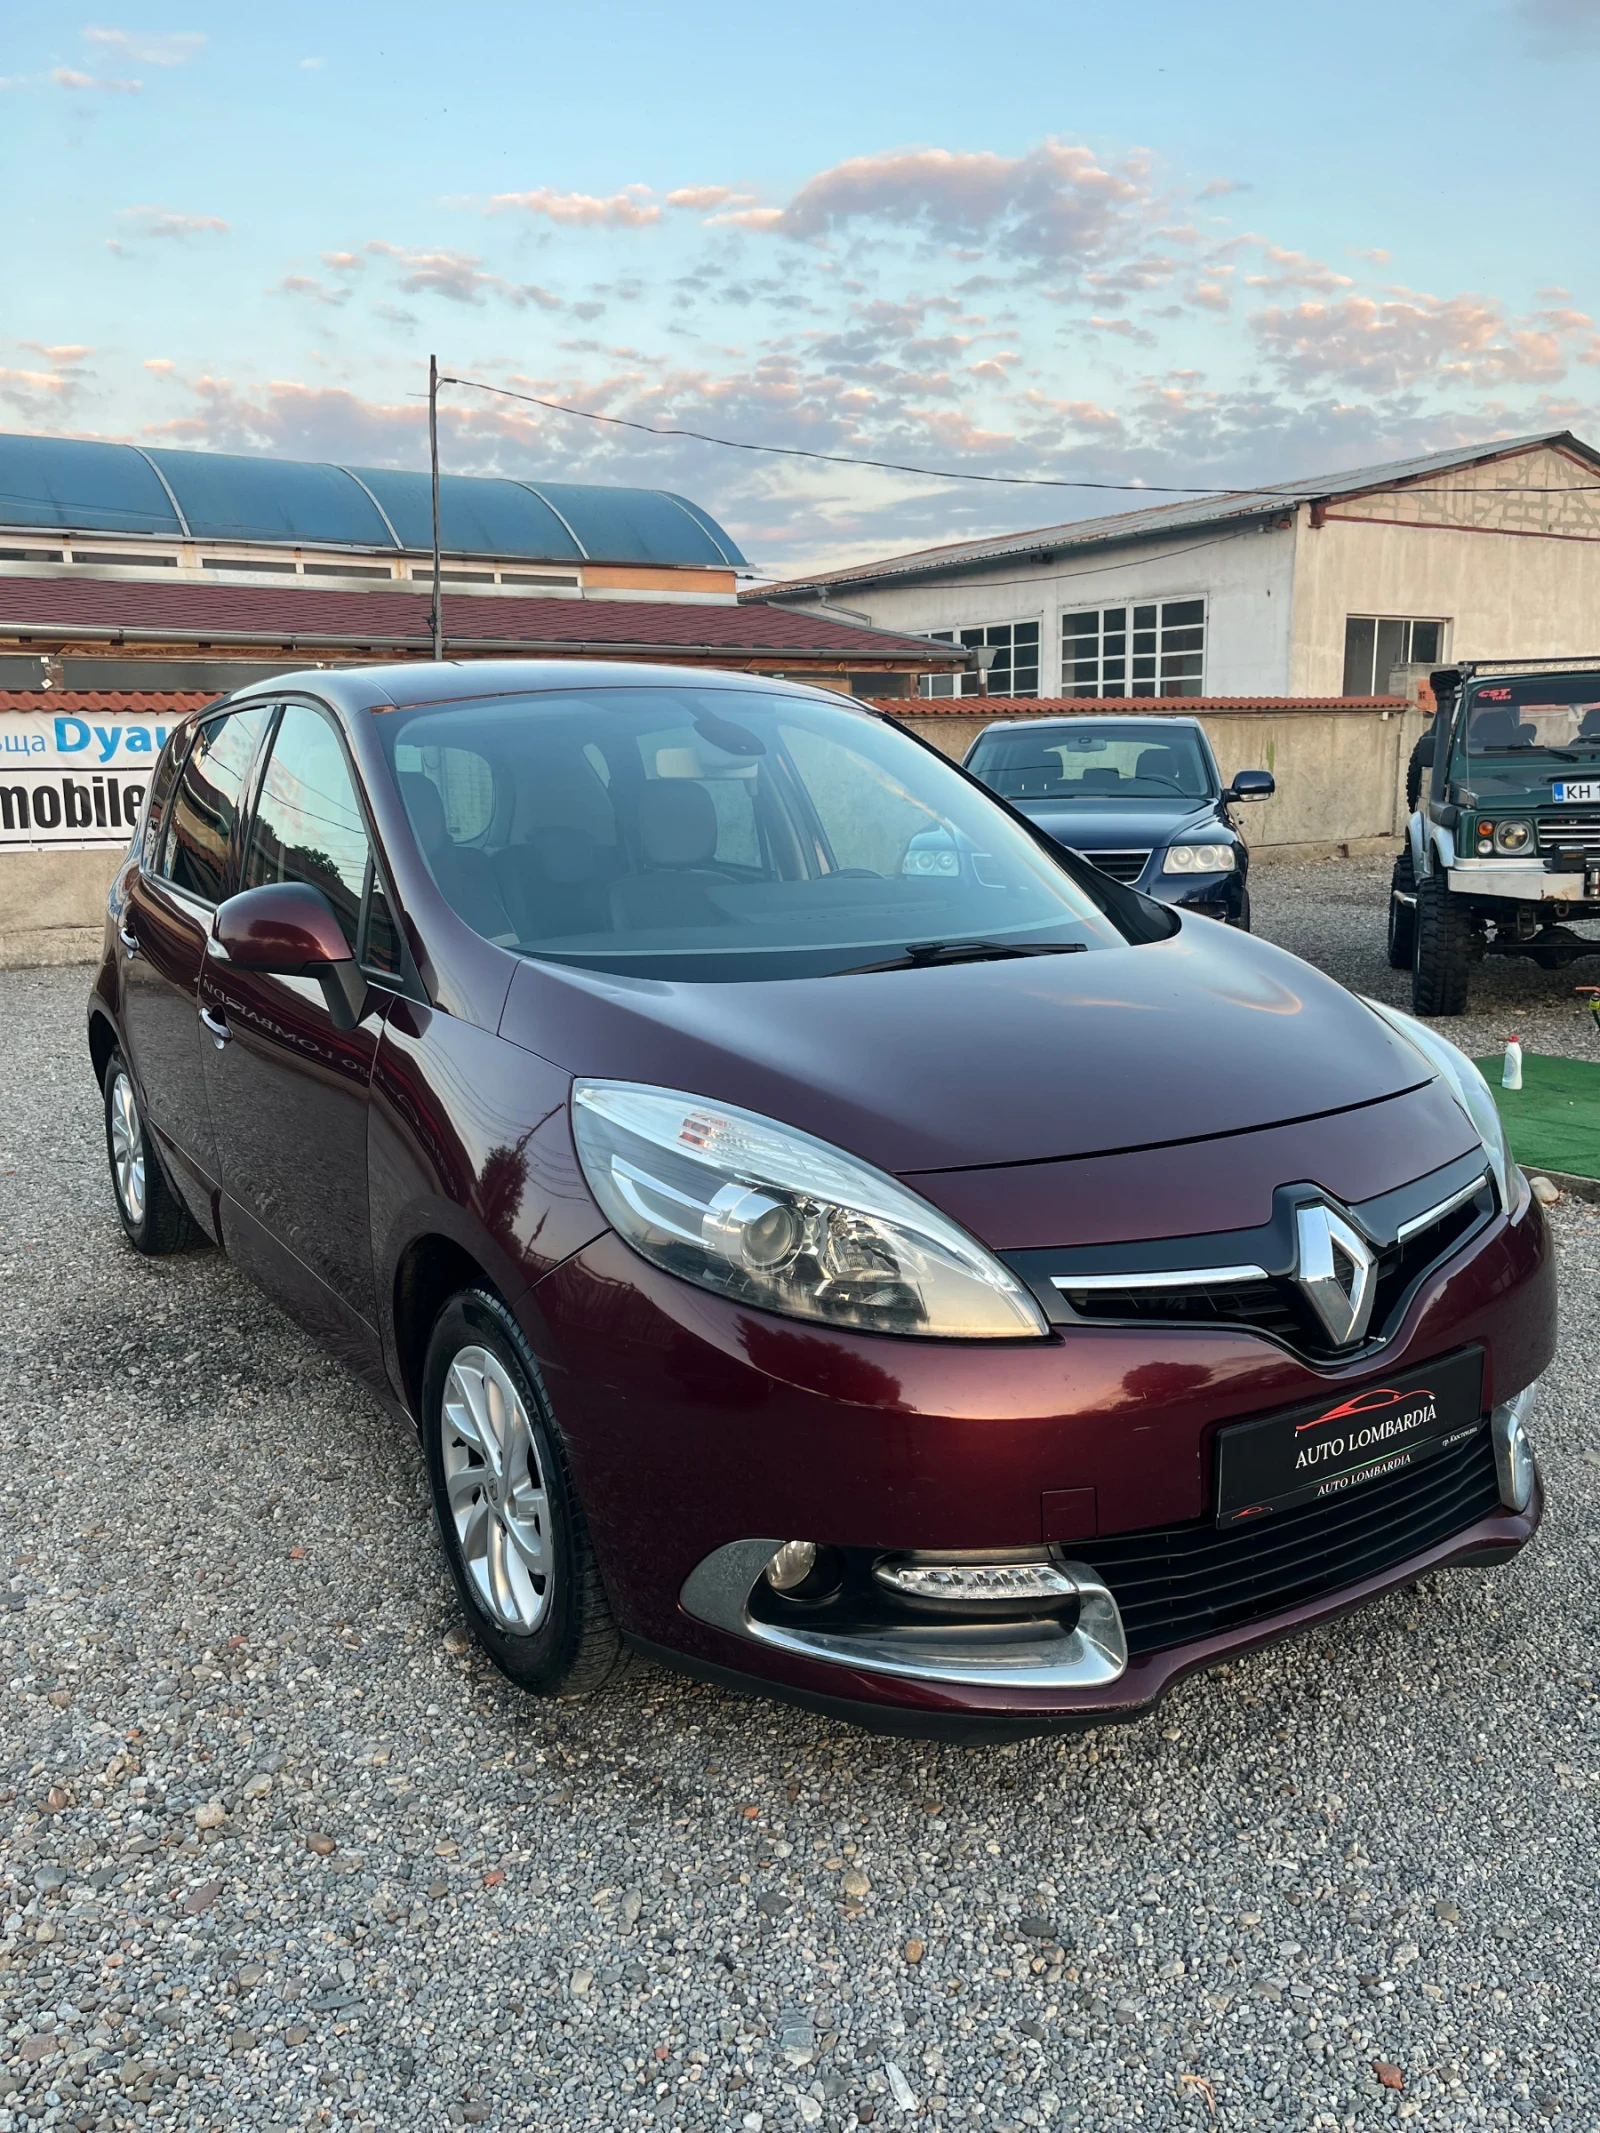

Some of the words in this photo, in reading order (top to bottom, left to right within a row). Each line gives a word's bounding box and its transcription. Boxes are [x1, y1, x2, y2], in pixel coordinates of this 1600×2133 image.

[1478, 688, 1511, 698] CST
[0, 735, 46, 757] ща
[1295, 1438, 1344, 1469] AUTO
[1349, 1404, 1437, 1452] LOMBARDIA
[1317, 1477, 1349, 1496] AUTO
[1351, 1454, 1412, 1485] LOMBARDIA
